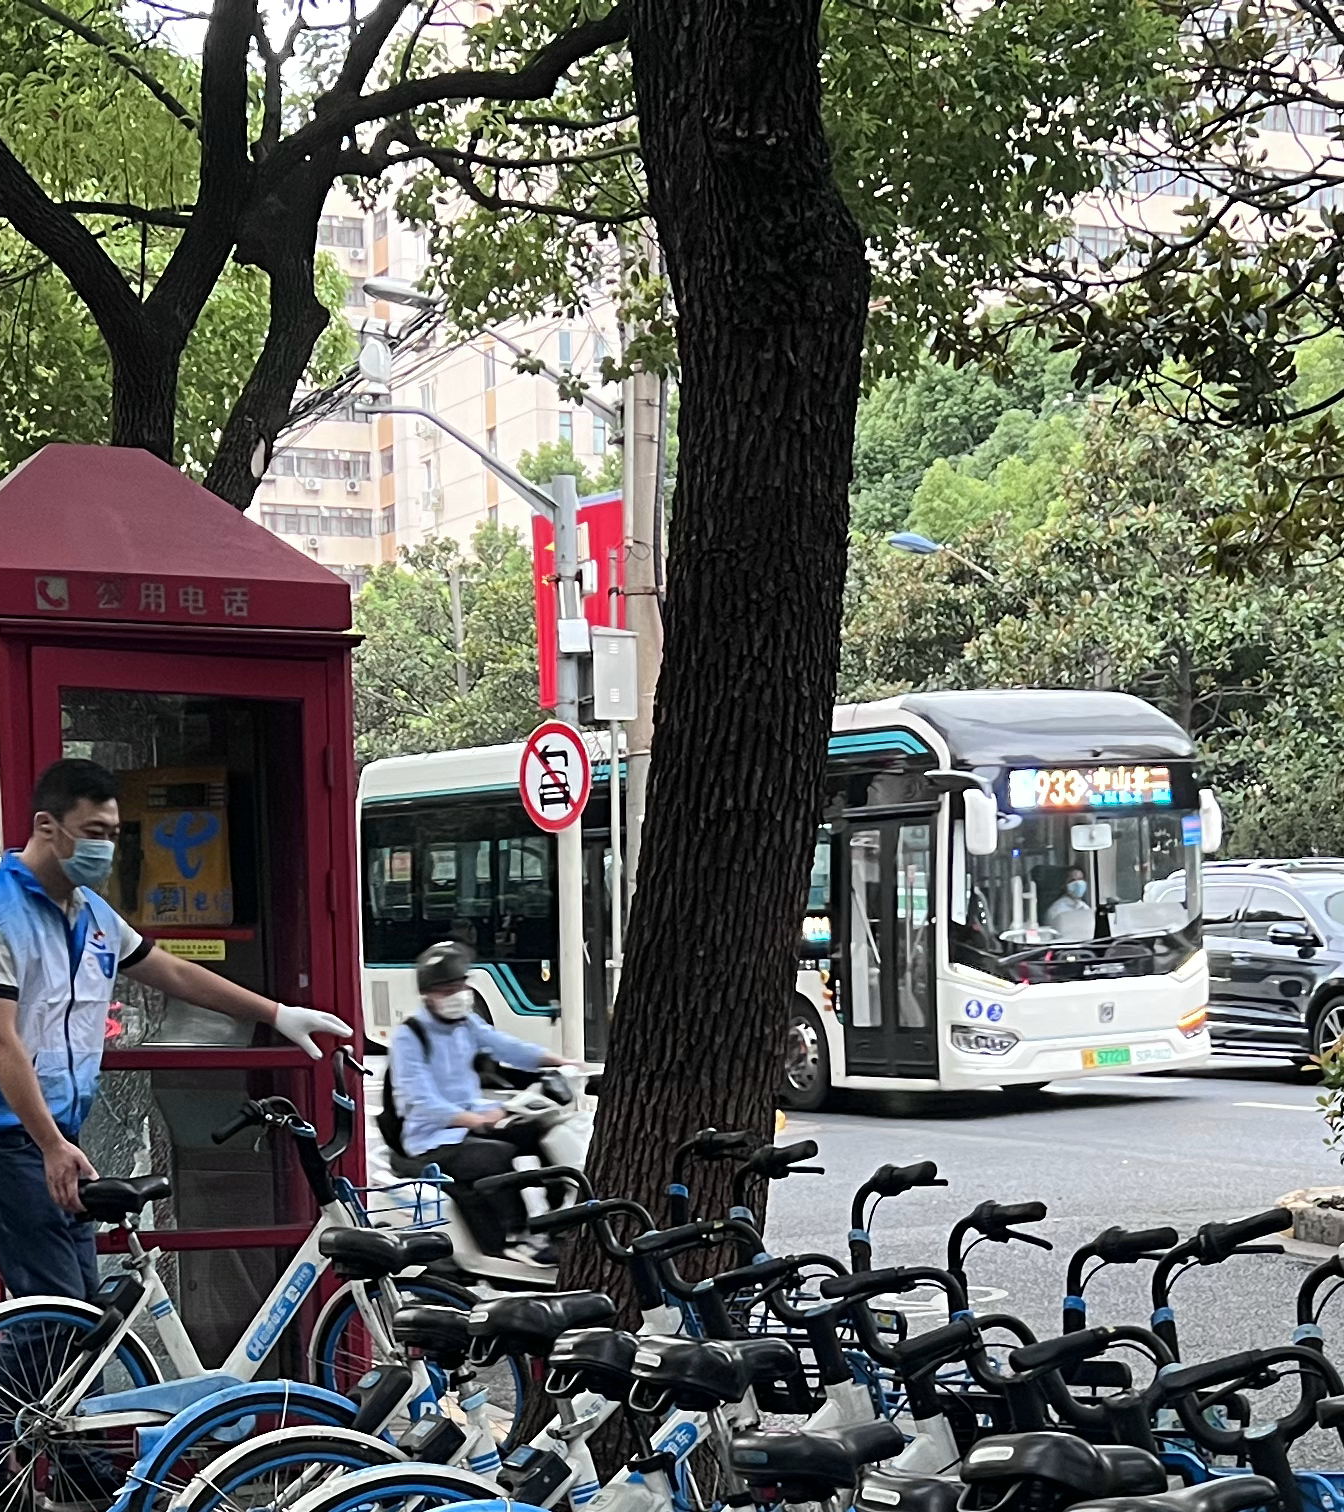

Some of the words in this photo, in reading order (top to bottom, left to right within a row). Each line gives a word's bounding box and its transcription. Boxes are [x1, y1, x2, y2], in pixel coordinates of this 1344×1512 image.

[96, 580, 249, 617] 公用电话
[1035, 769, 1082, 805] 933
